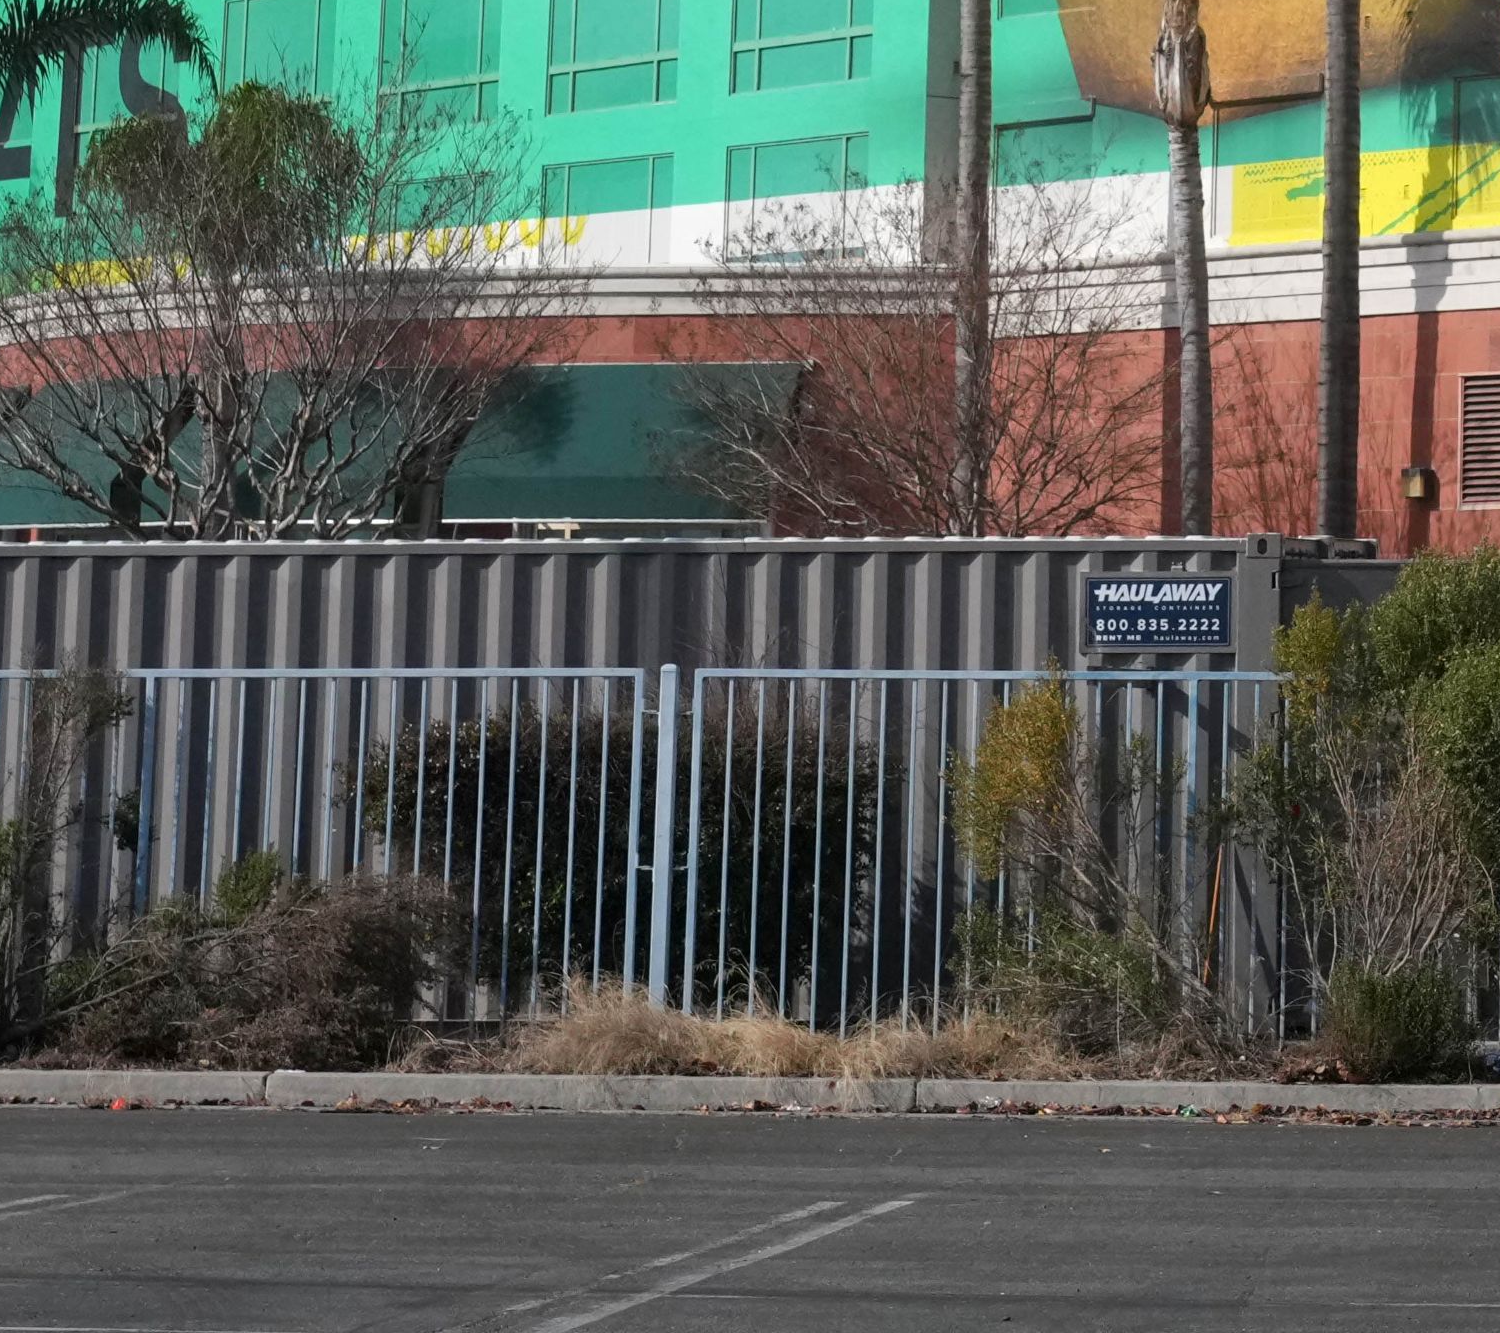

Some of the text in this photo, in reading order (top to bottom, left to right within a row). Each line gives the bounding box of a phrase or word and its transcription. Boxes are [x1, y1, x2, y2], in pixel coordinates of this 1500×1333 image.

[1094, 583, 1223, 604] HAULAWAY
[1096, 619, 1220, 631] 800.835.2222
[1154, 634, 1220, 642] haulaway.com
